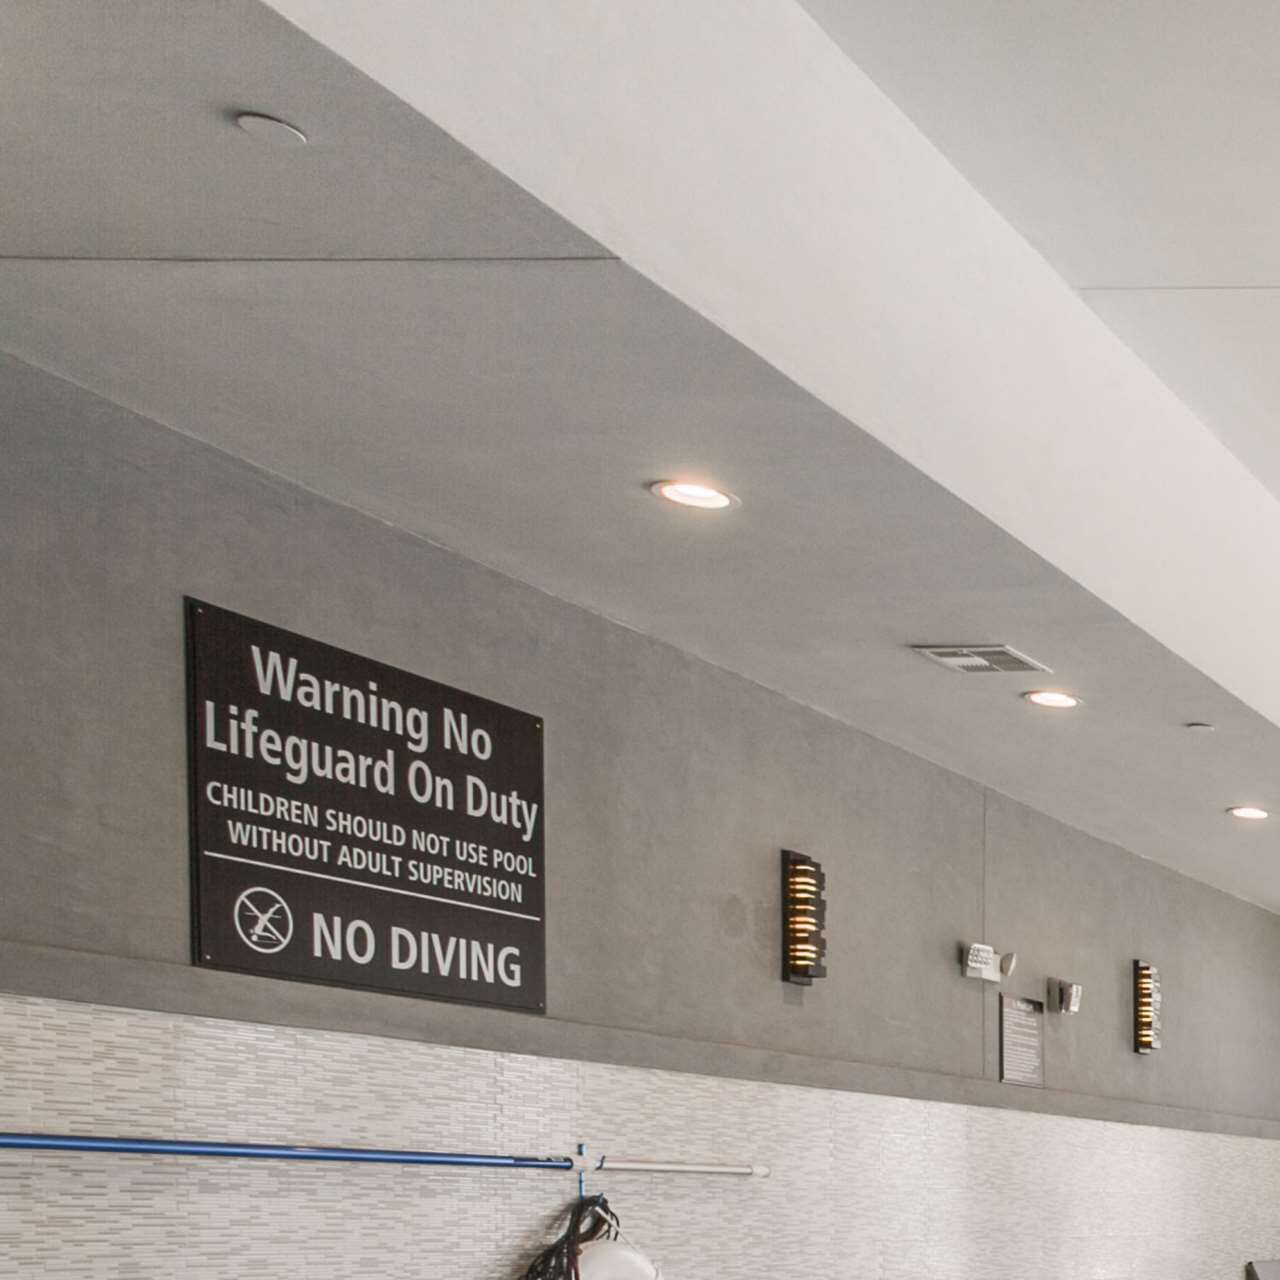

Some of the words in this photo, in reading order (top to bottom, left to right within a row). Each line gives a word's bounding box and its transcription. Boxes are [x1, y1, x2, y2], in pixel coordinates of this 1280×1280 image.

[251, 645, 428, 752] Warning
[444, 708, 491, 760] No
[206, 701, 394, 795] Lifeguard
[408, 760, 453, 810] On
[467, 775, 537, 841] Duty
[207, 782, 318, 827] CHILDREN
[326, 809, 406, 846] SHOULD
[412, 830, 450, 856] NOT
[456, 840, 488, 866] USE
[493, 849, 536, 877] POOL
[228, 820, 331, 862] WITHOUT
[337, 845, 402, 877] ADULT
[408, 860, 522, 903] SUPERVISION
[313, 913, 375, 964] NO
[391, 927, 521, 987] DIVING
